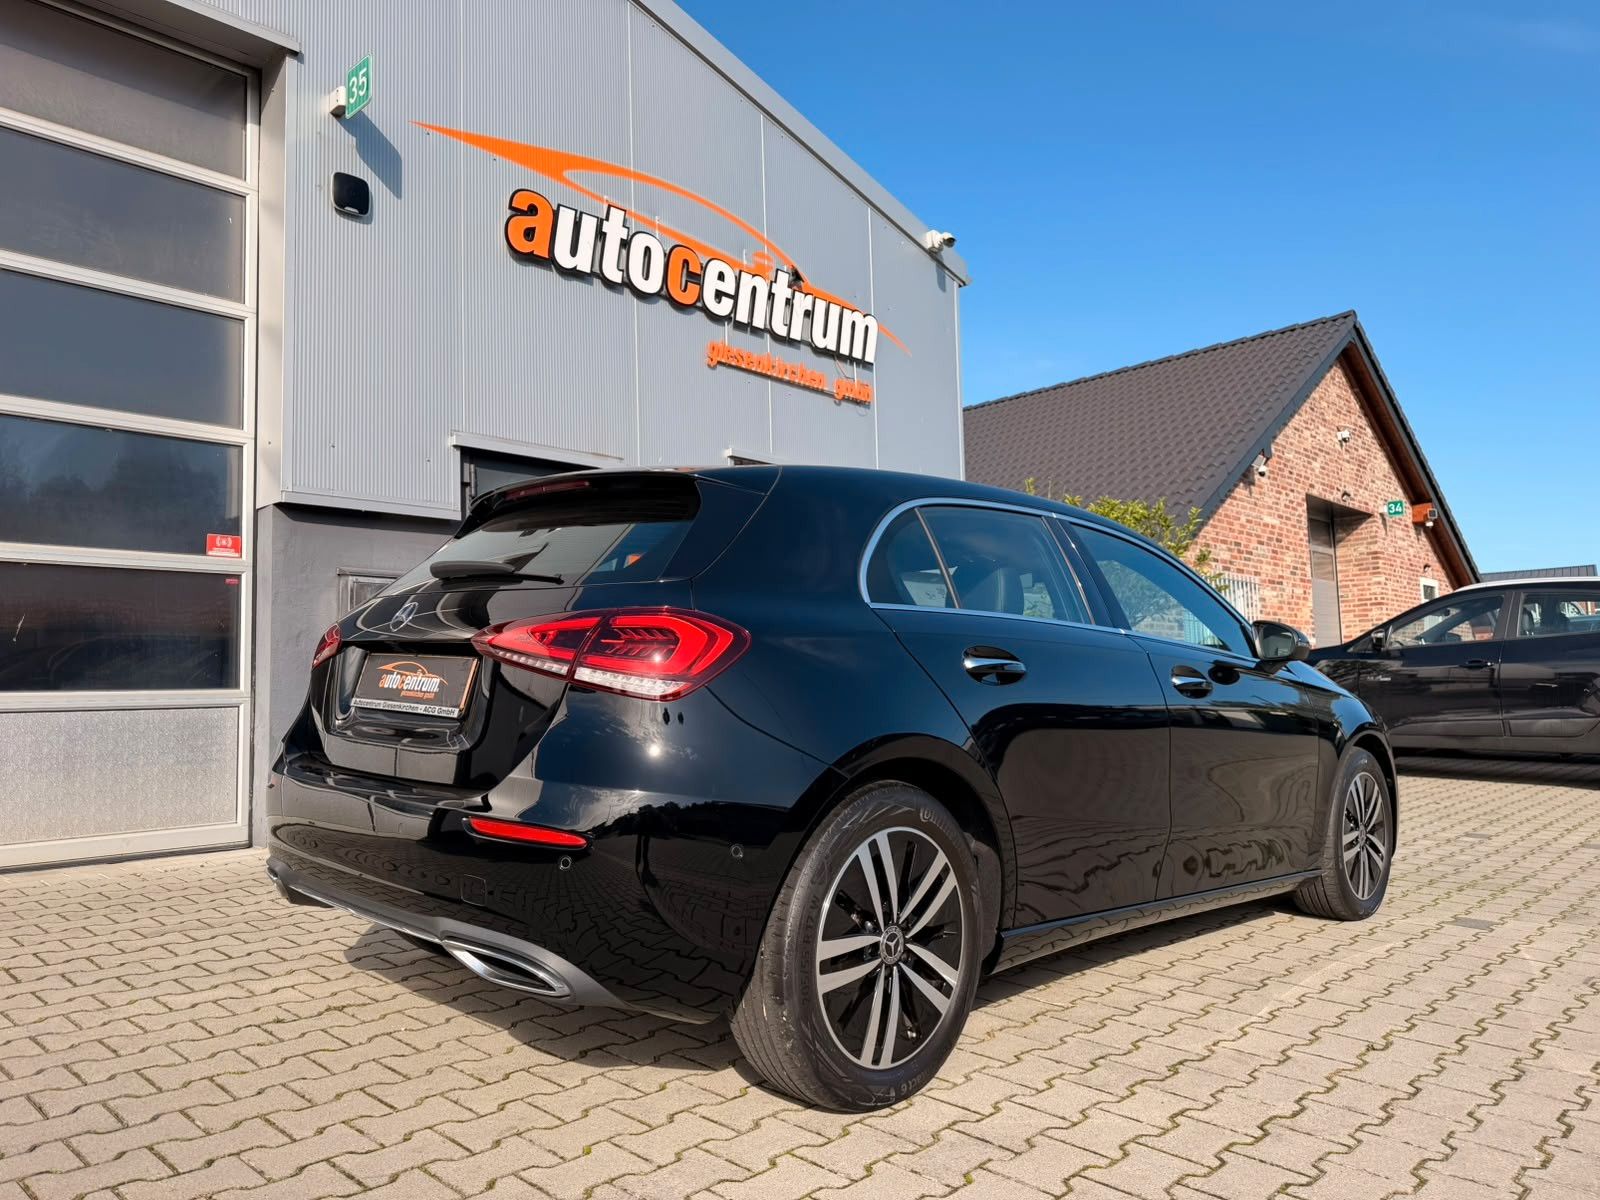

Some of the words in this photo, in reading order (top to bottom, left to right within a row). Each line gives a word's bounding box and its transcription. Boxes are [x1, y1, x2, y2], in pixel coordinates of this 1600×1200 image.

[349, 67, 367, 103] 35
[504, 188, 879, 365] autocentrum
[1388, 503, 1402, 514] 34
[423, 706, 436, 714] ACG
[437, 707, 455, 716] GmbH
